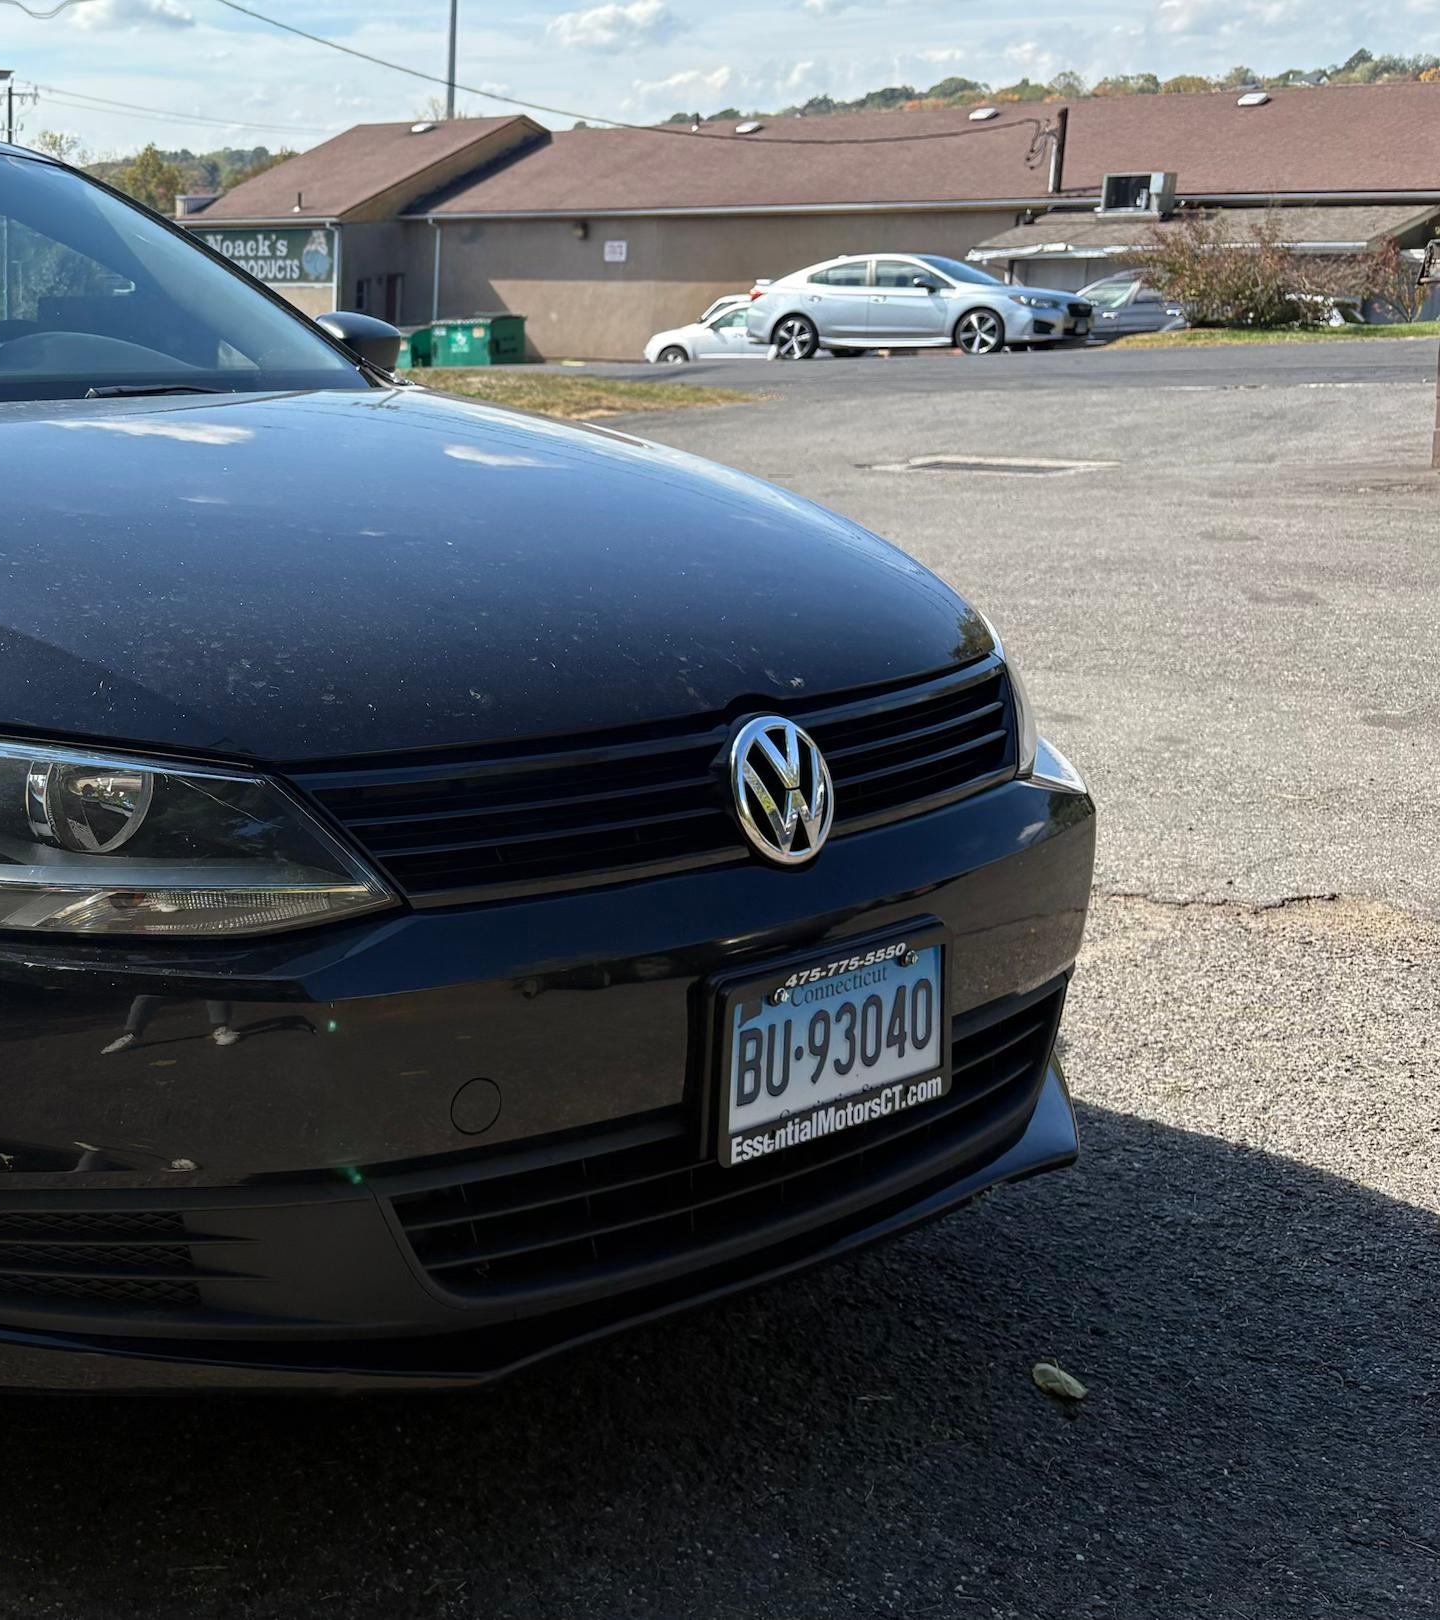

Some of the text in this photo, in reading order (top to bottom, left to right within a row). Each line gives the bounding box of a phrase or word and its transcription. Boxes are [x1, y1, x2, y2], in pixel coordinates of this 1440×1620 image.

[205, 233, 288, 257] Noack's
[784, 942, 907, 988] 475-775-5550
[791, 965, 888, 1007] Connecticut
[730, 1076, 942, 1165] EssentialMotorsCT.com
